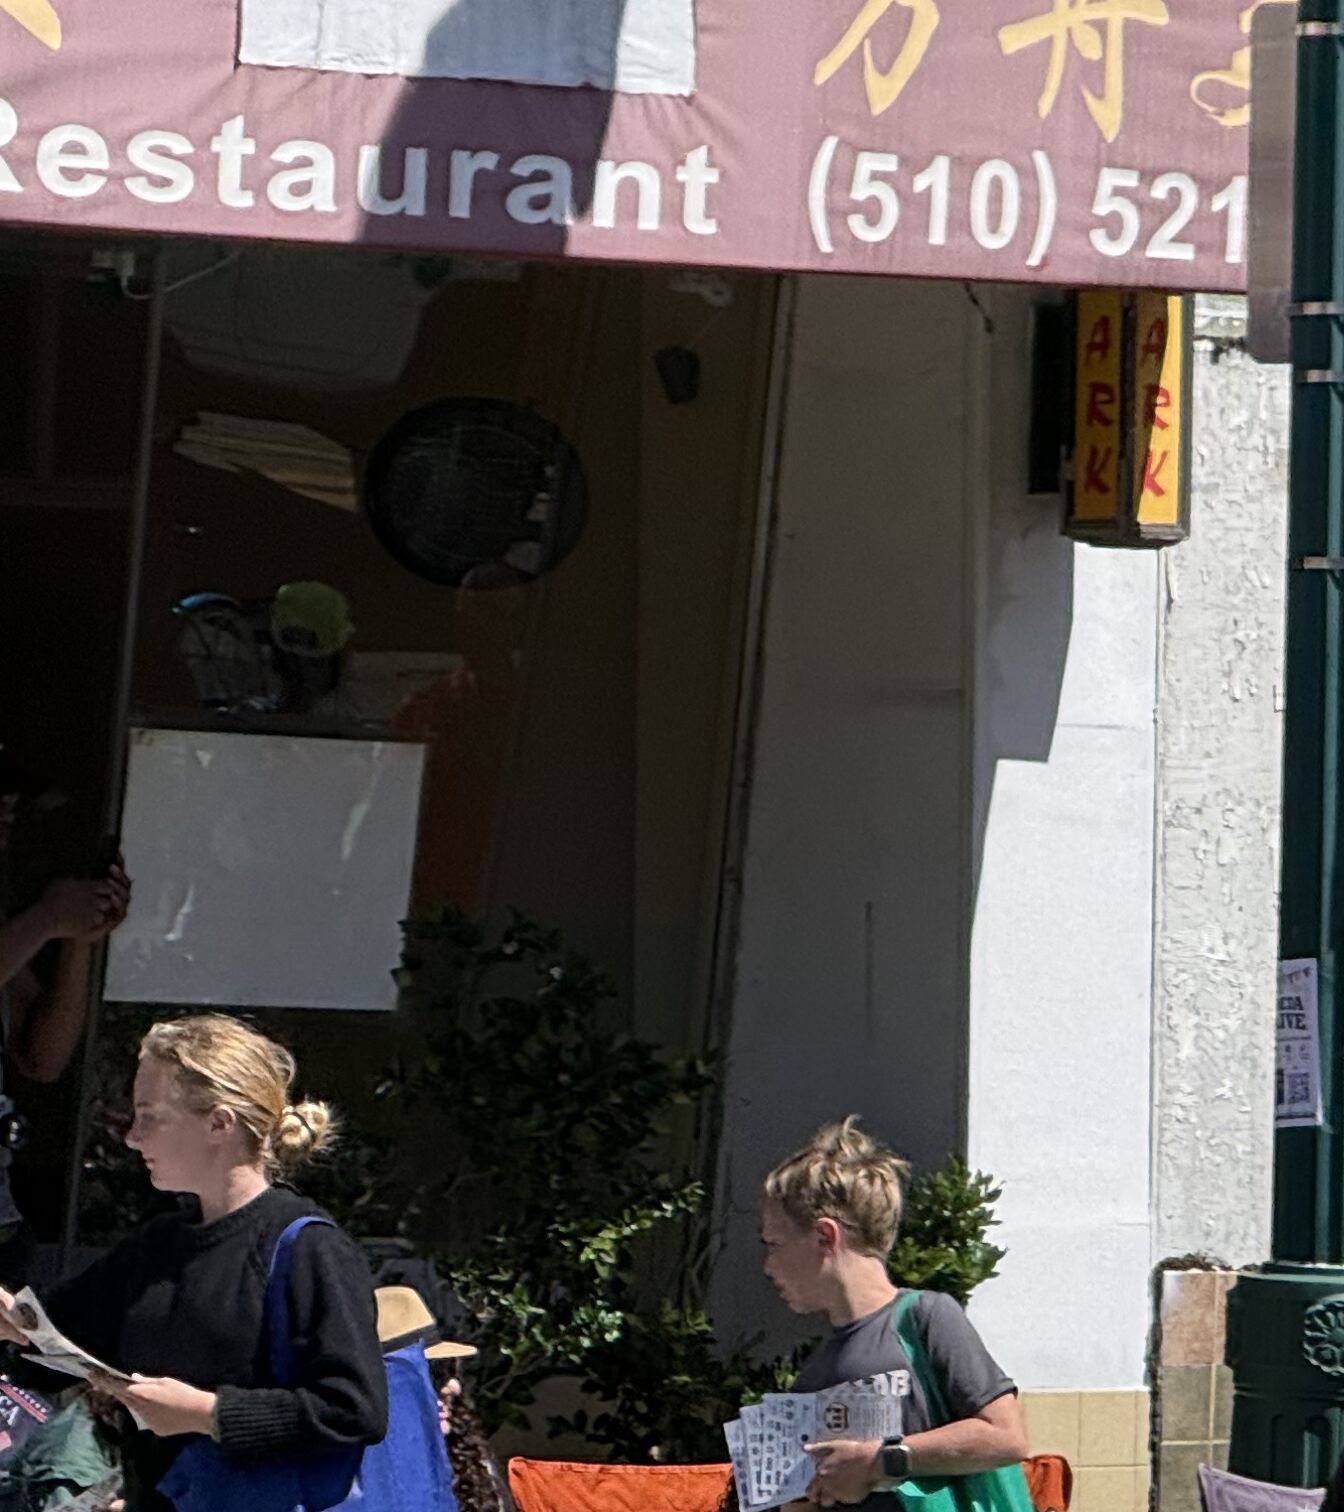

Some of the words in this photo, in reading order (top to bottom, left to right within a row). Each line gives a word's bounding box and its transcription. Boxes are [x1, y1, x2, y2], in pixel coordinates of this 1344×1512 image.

[0, 97, 721, 236] estaurant
[808, 136, 1057, 266] (510)
[1084, 315, 1116, 495] ARK
[1140, 317, 1171, 497] ARK
